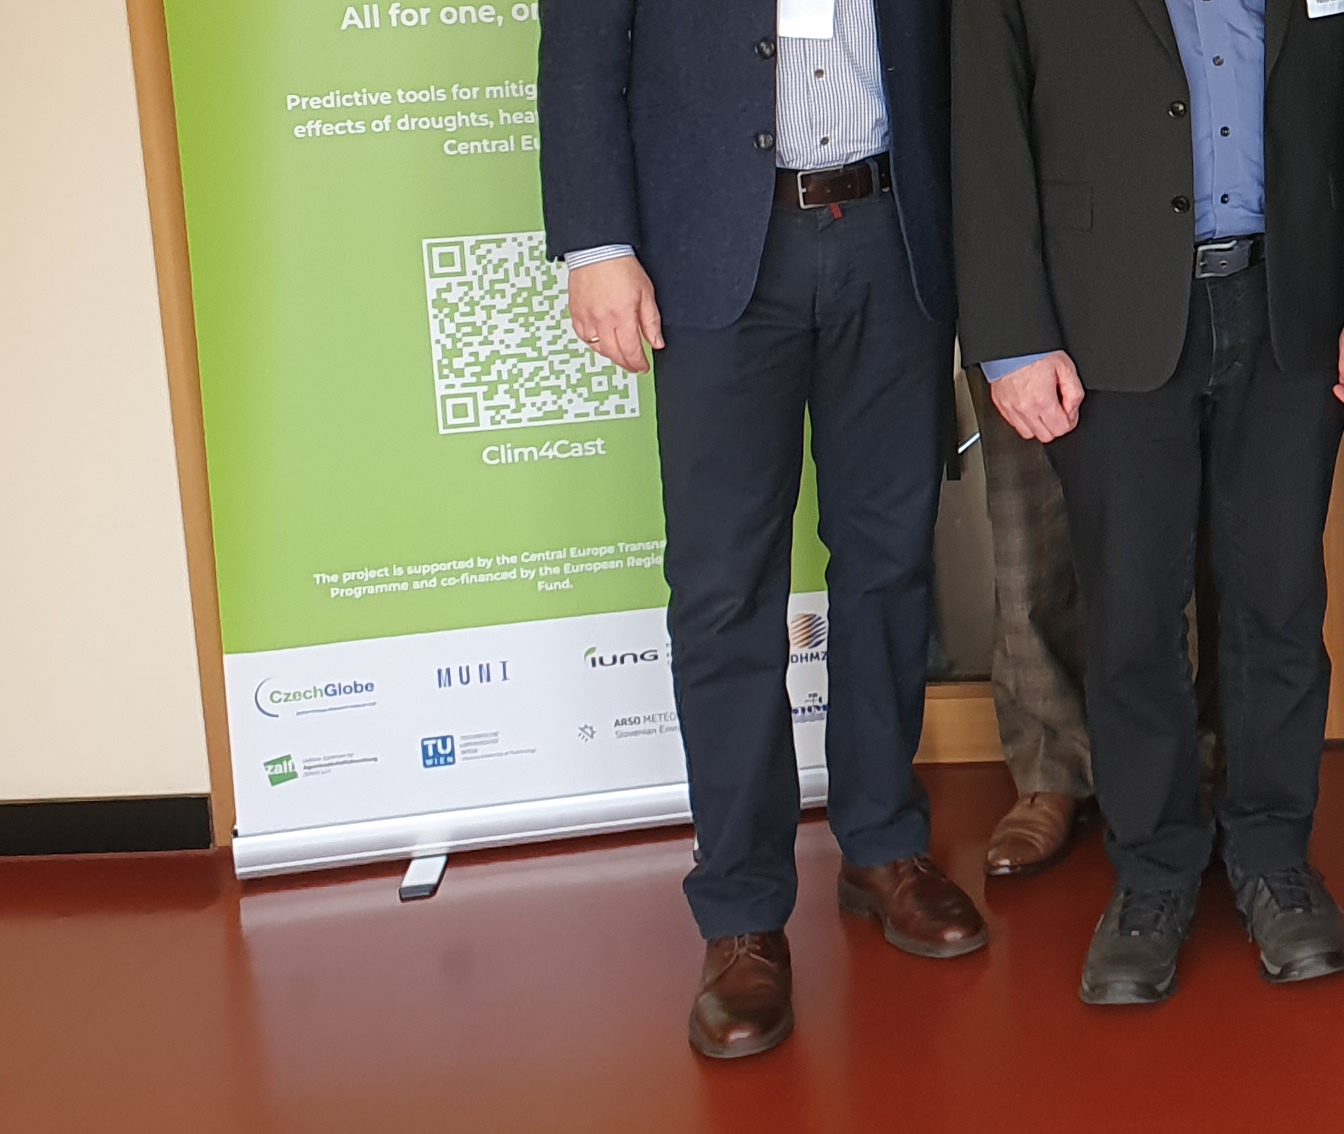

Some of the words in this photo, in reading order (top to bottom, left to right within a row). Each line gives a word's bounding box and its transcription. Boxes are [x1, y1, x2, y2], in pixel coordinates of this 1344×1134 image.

[340, 4, 380, 30] All
[388, 2, 431, 27] for
[440, 4, 504, 27] one,
[286, 88, 392, 111] Predictive
[397, 85, 446, 104] tools
[452, 83, 479, 100] for
[485, 80, 537, 101] mitig
[293, 119, 366, 138] effects
[371, 115, 392, 132] of
[397, 111, 494, 132] droughts,
[499, 109, 538, 126] hea
[443, 135, 514, 155] Central
[481, 437, 607, 465] Clim4Cast
[313, 573, 339, 584] The
[342, 568, 390, 583] project
[393, 565, 404, 576] is
[407, 557, 474, 575] supported
[477, 556, 493, 569] by
[496, 554, 518, 565] the
[521, 548, 566, 562] Central
[570, 545, 614, 558] Europe
[330, 581, 408, 598] Programme
[412, 577, 437, 589] and
[440, 568, 517, 587] co-financed
[520, 568, 536, 580] by
[539, 565, 560, 577] the
[564, 559, 623, 574] European
[537, 578, 573, 591] Fund.
[269, 680, 375, 704] CzechGlobe
[614, 716, 641, 727] ARSO
[423, 738, 452, 756] TU
